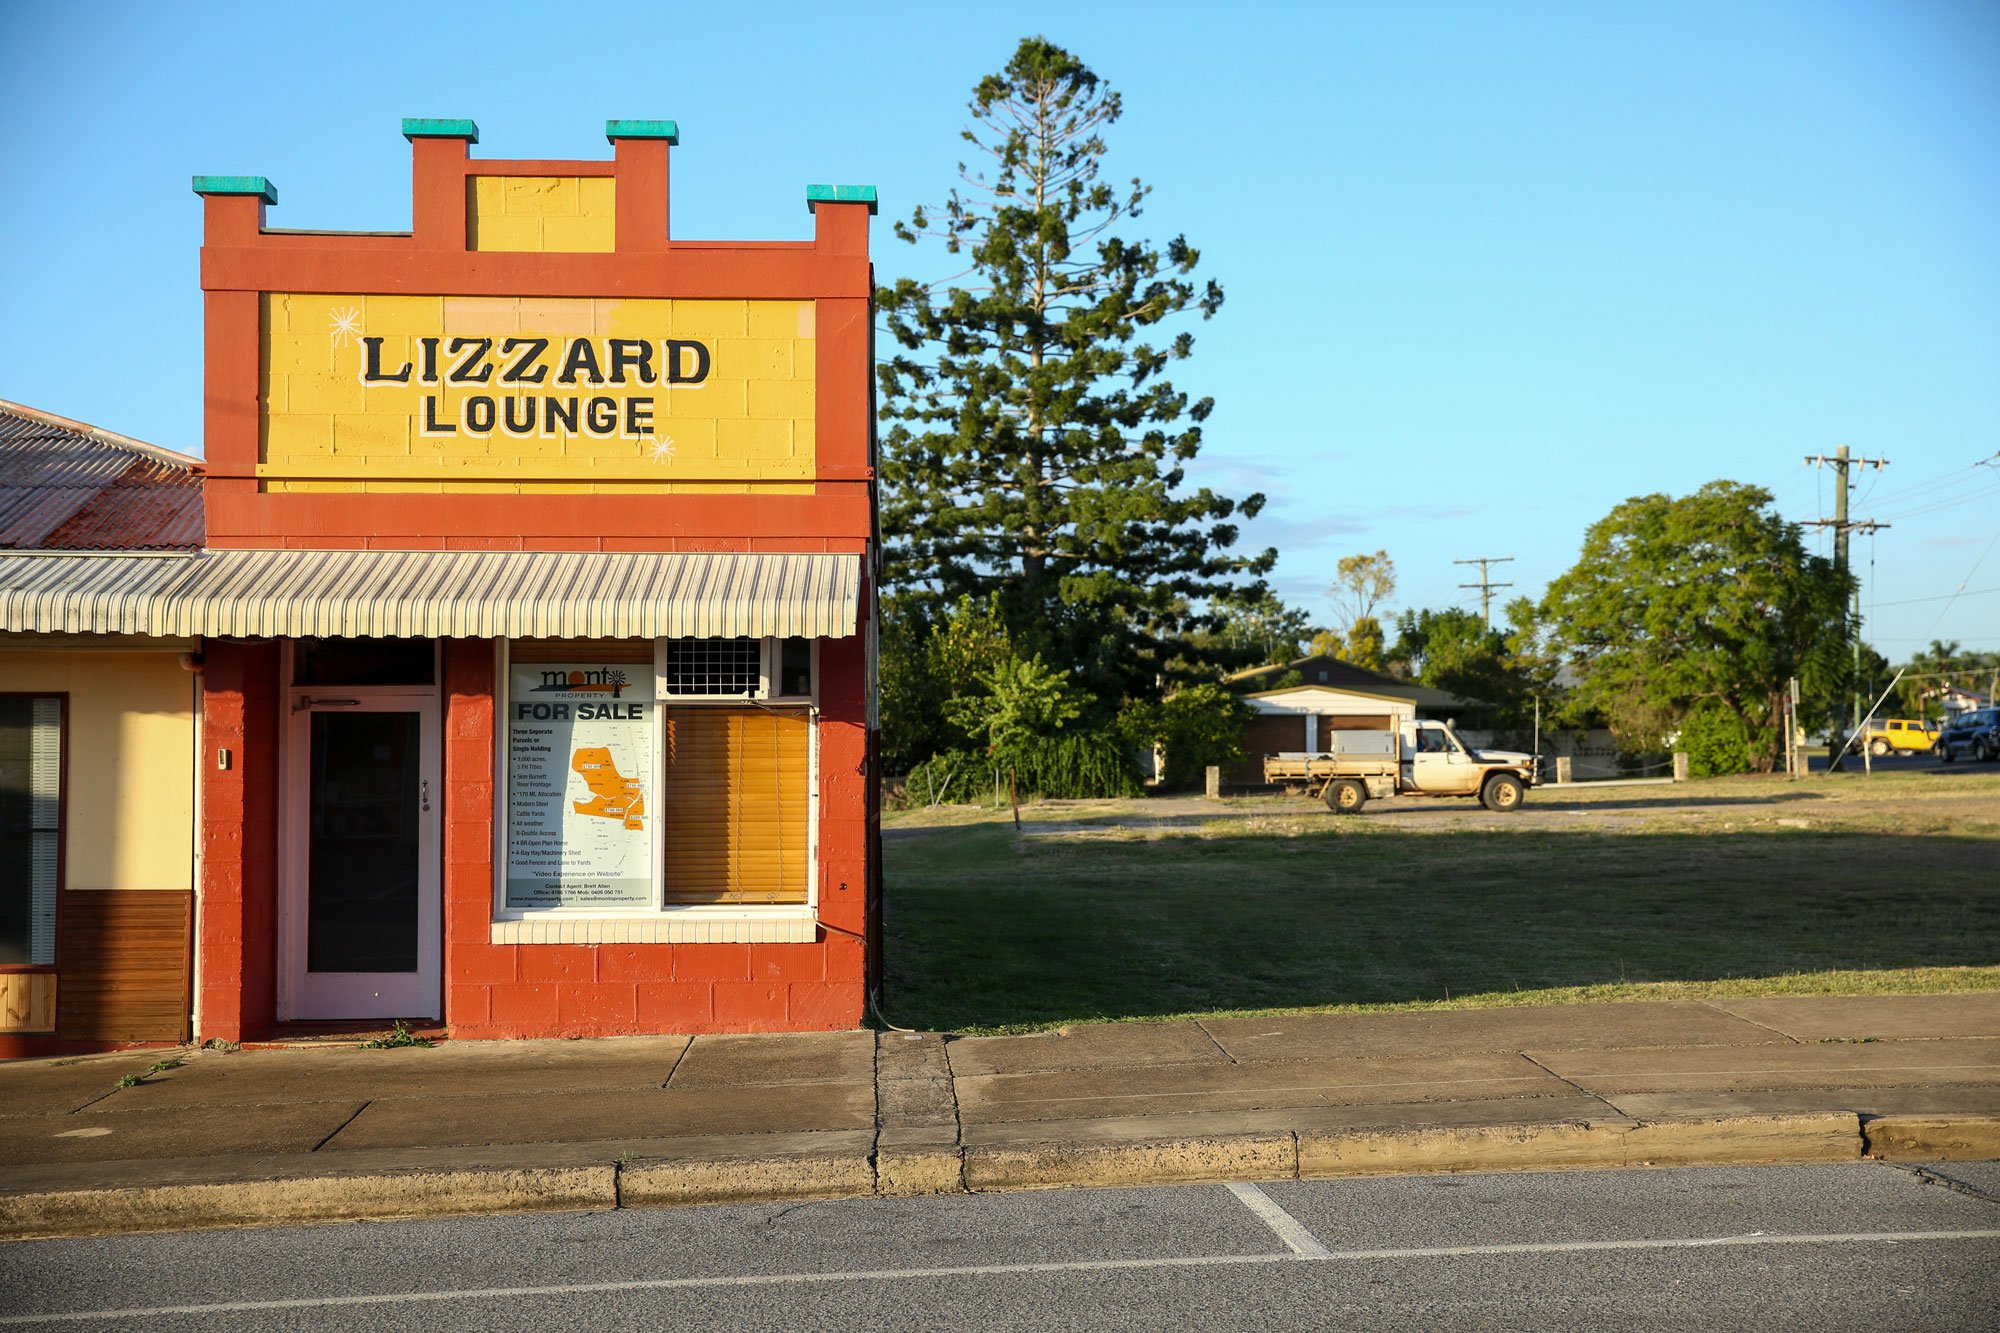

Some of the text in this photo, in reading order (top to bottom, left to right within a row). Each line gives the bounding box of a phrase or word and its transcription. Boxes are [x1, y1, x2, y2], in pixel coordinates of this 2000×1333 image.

[361, 336, 712, 386] LIZZARD
[424, 396, 656, 436] LOUNGE
[518, 703, 644, 720] FOR SALE
